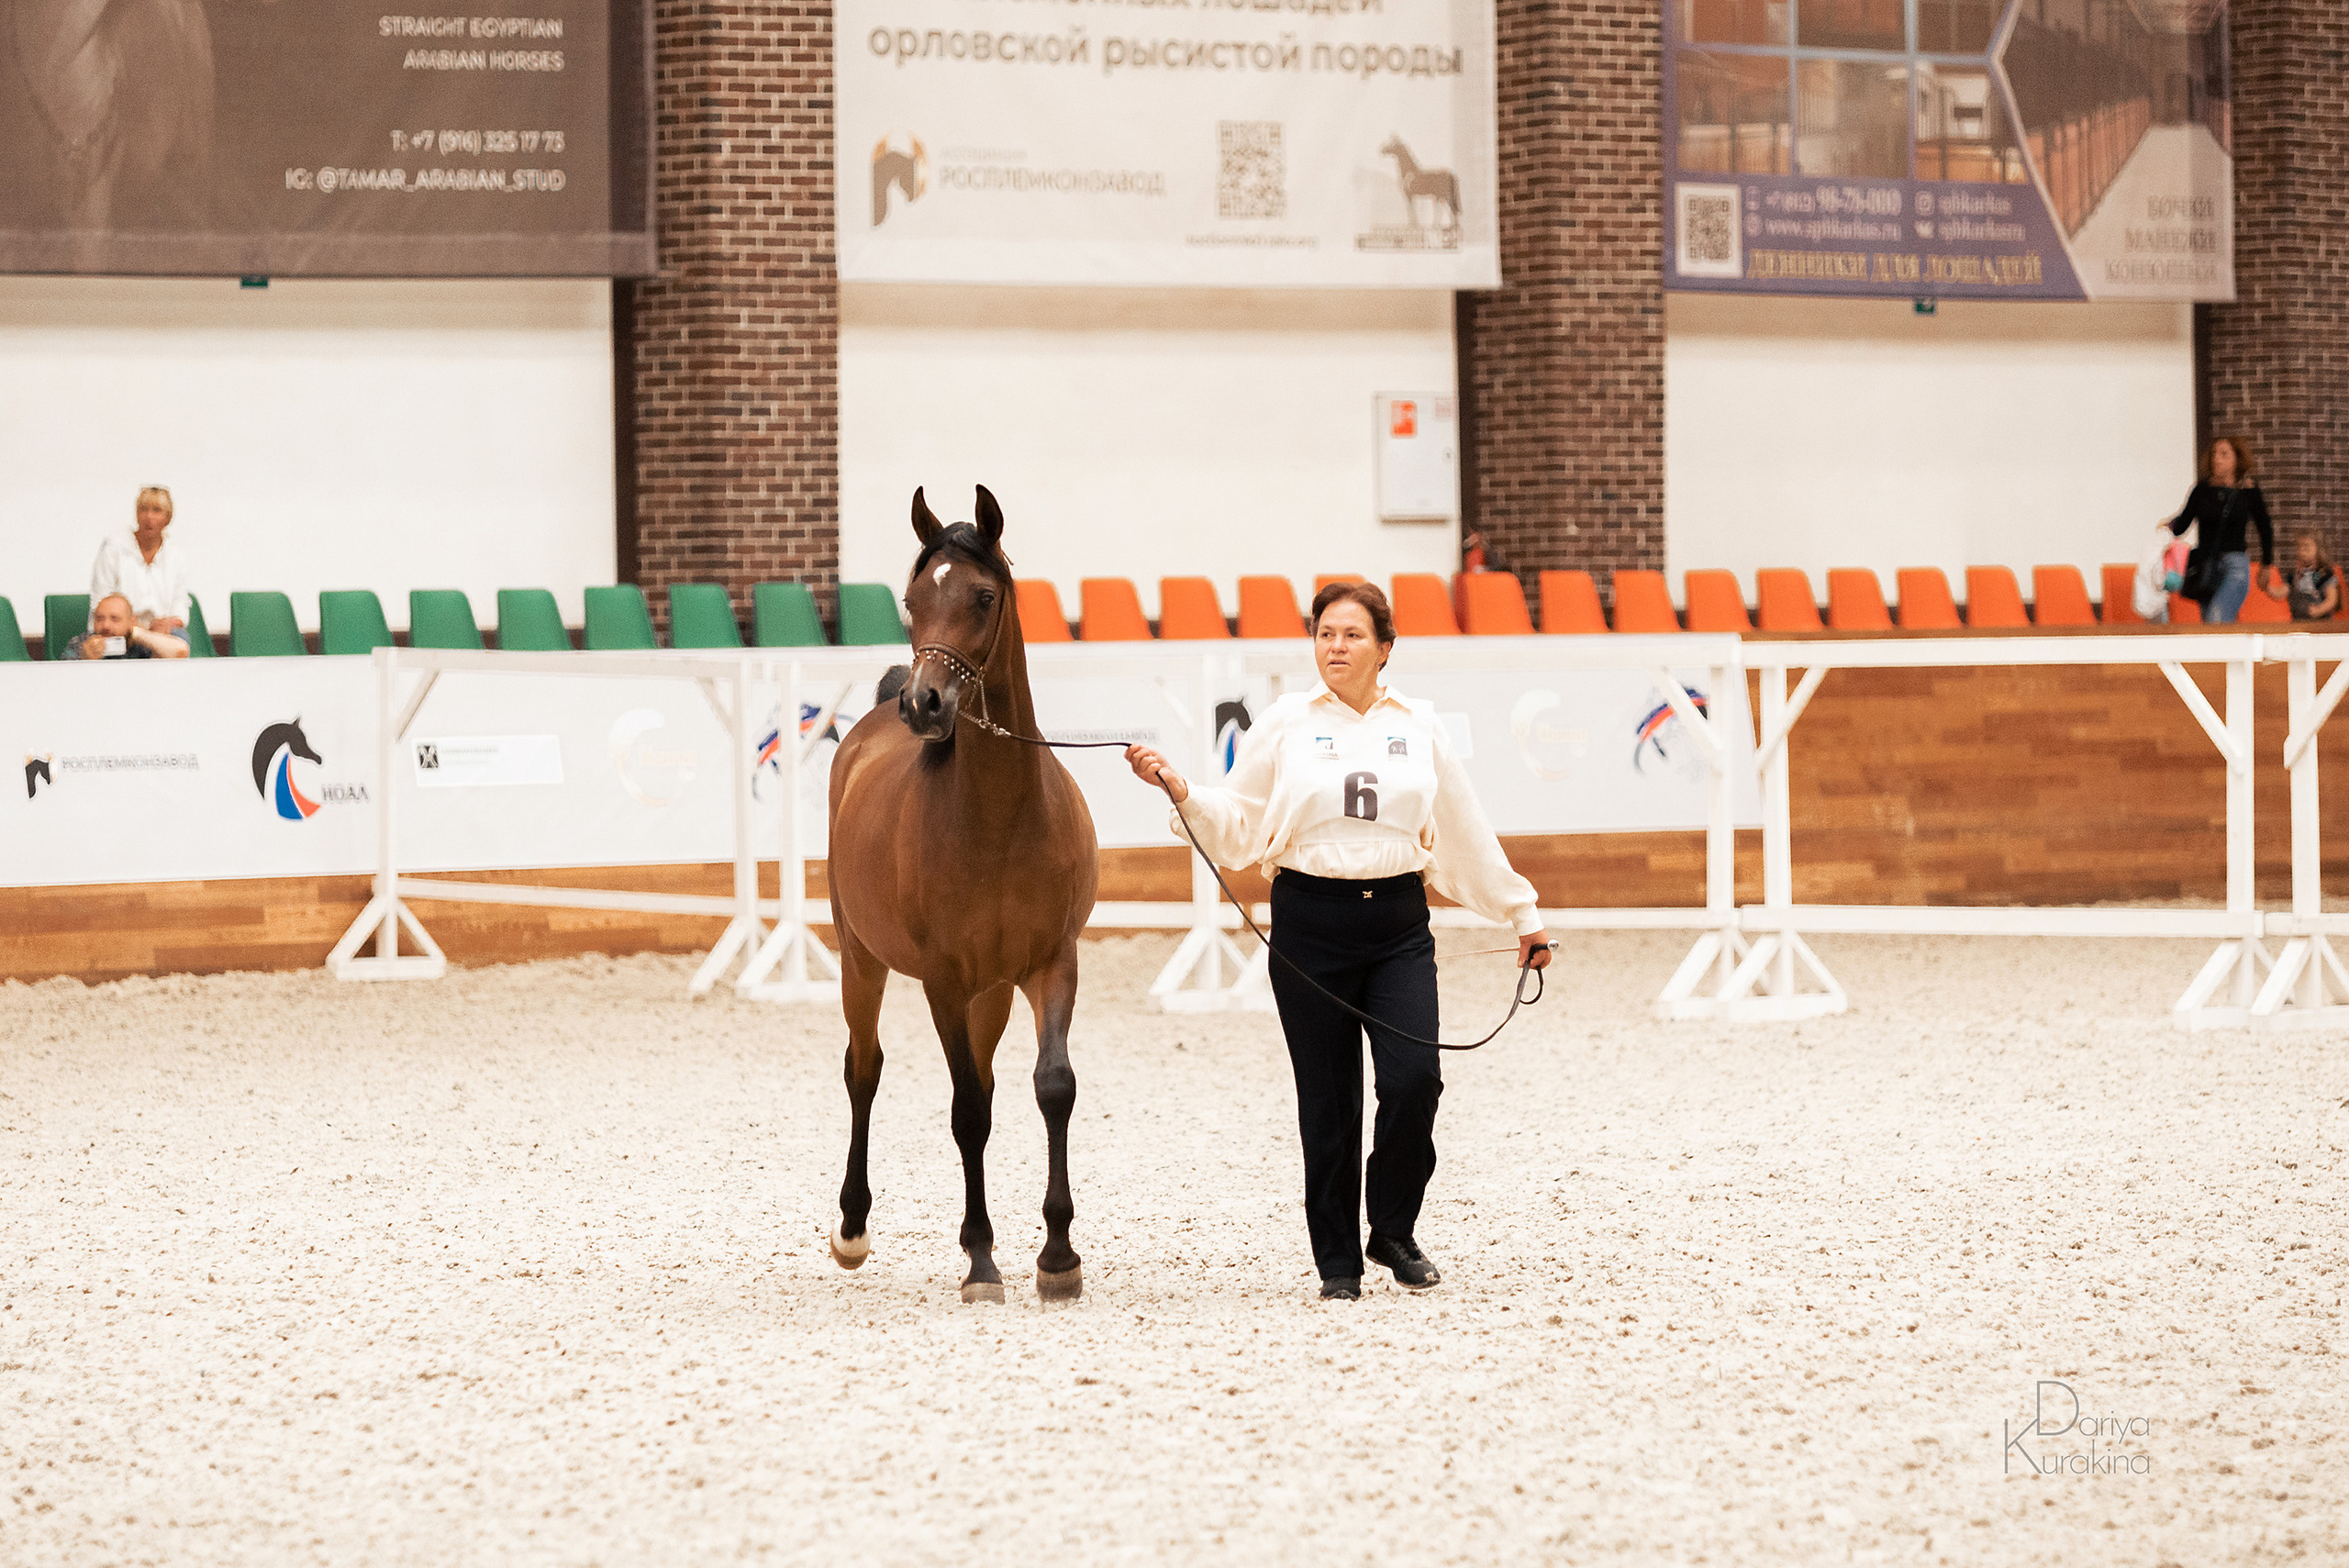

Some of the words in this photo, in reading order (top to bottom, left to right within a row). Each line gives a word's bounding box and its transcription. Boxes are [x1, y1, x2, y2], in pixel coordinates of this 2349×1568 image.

[379, 16, 467, 37] STRAIGHT
[470, 17, 563, 39] EGYPTIAN
[403, 49, 486, 70] ARABIAN
[489, 50, 565, 72] HORSES
[868, 24, 1090, 68] орловской
[1105, 31, 1299, 77] рысистой
[1310, 41, 1464, 81] породы
[411, 130, 435, 151] +7
[519, 130, 541, 153] 17
[285, 168, 313, 190] IG:
[317, 166, 566, 193] @TAMAR_ARABIAN_STUD
[1344, 771, 1378, 822] 6
